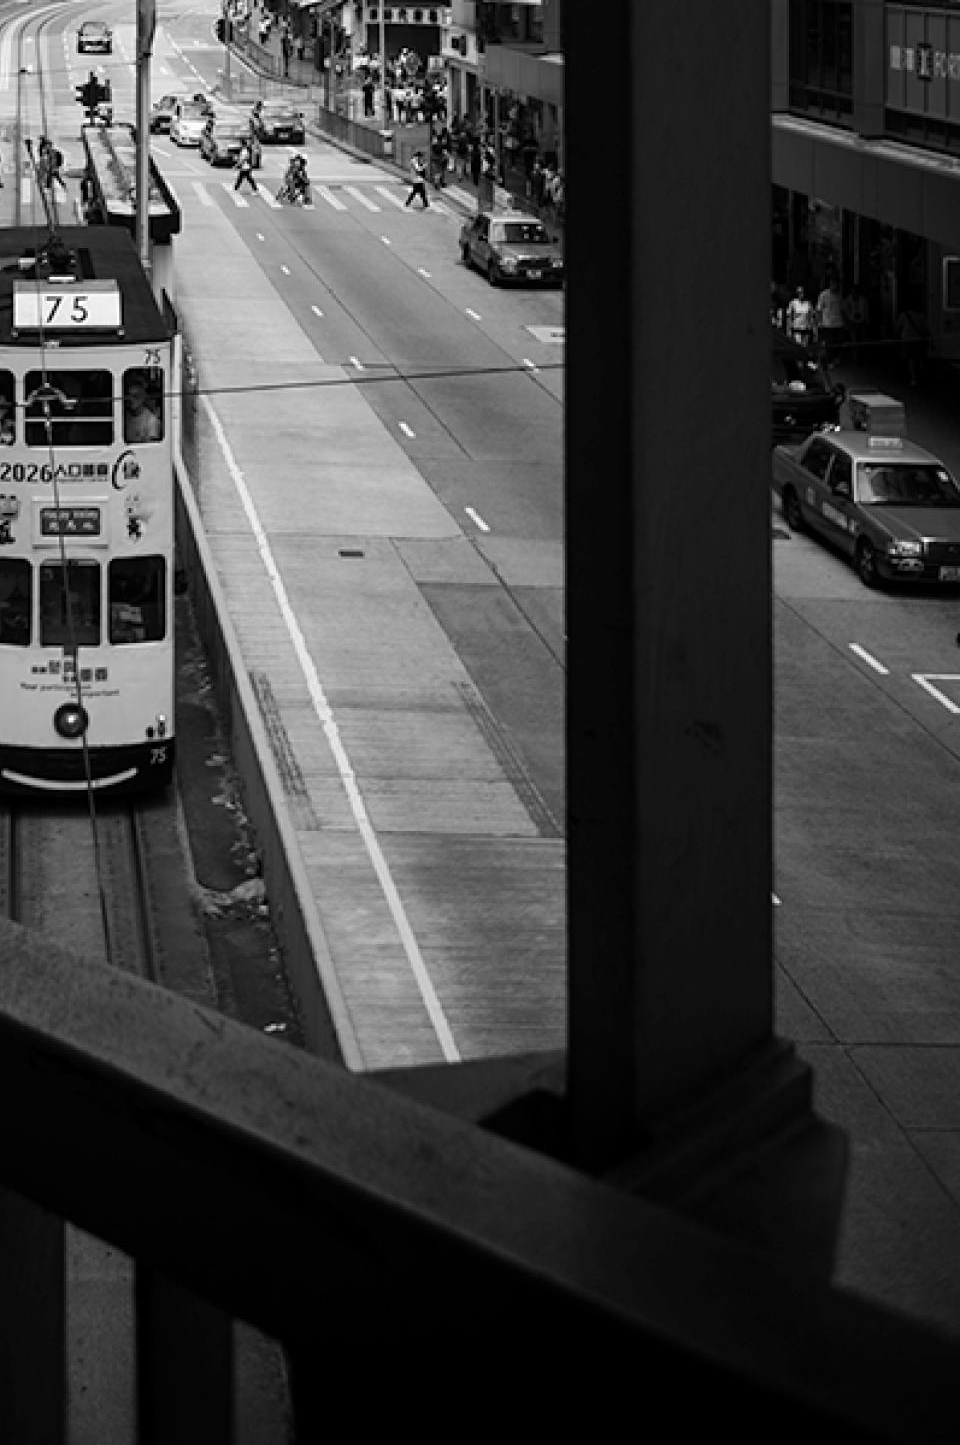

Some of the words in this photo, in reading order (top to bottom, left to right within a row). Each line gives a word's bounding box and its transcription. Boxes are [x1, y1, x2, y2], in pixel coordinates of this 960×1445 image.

[44, 295, 89, 324] 75
[144, 349, 161, 366] 75
[149, 747, 168, 766] 75
